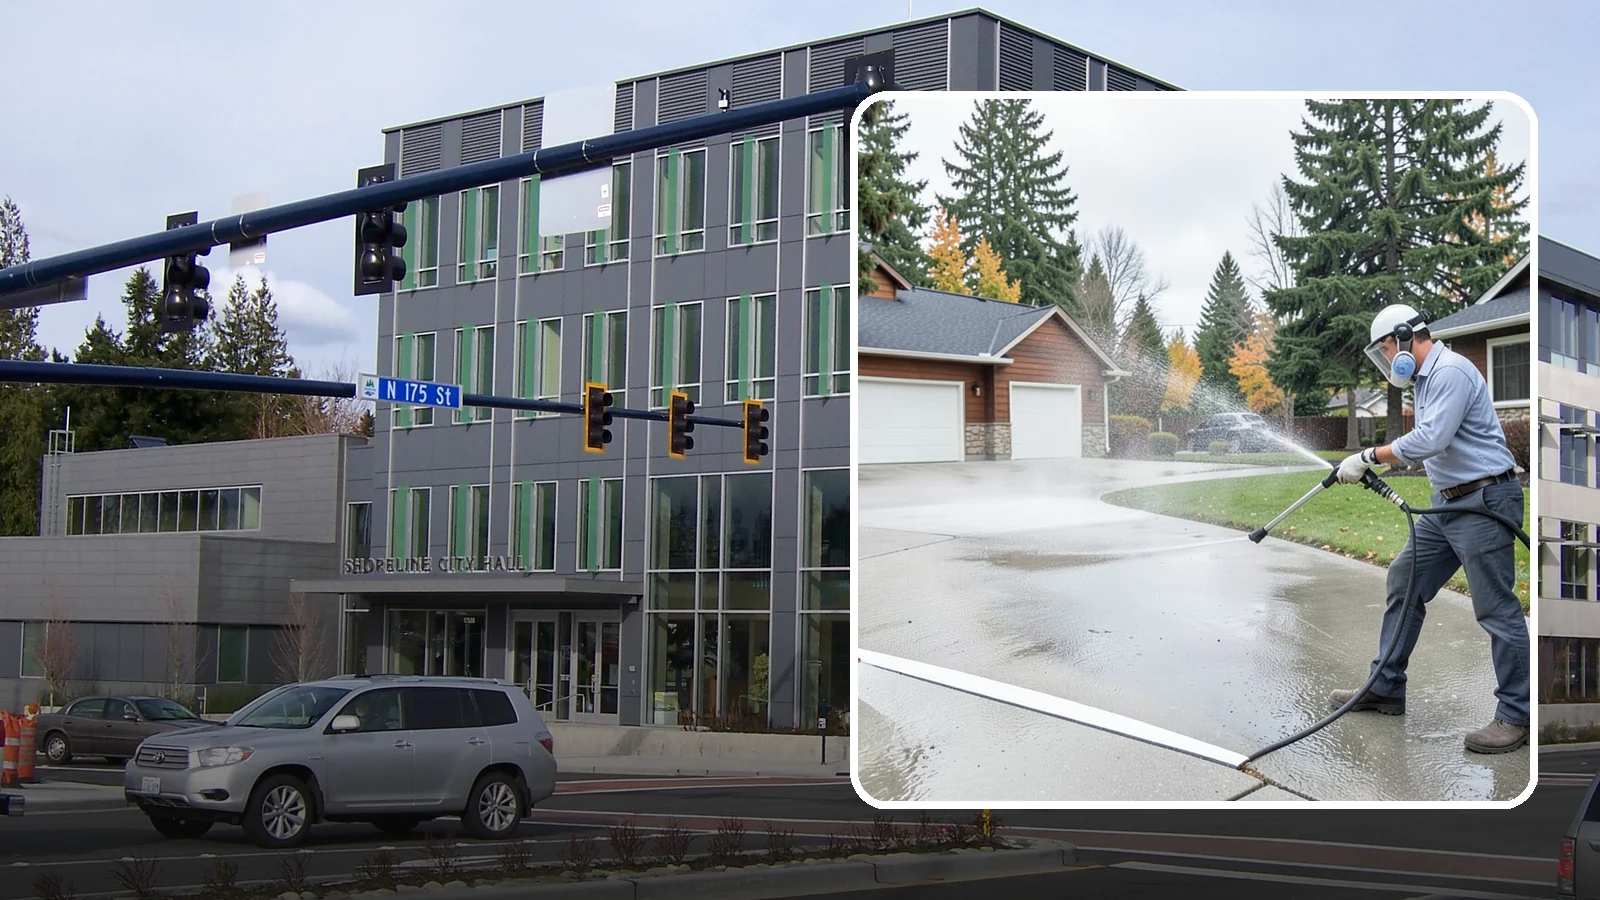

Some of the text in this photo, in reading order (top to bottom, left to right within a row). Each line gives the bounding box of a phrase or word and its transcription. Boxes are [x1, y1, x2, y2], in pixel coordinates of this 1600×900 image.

[387, 380, 452, 406] N 175 St
[345, 555, 526, 574] SHORELINE CITY HALL
